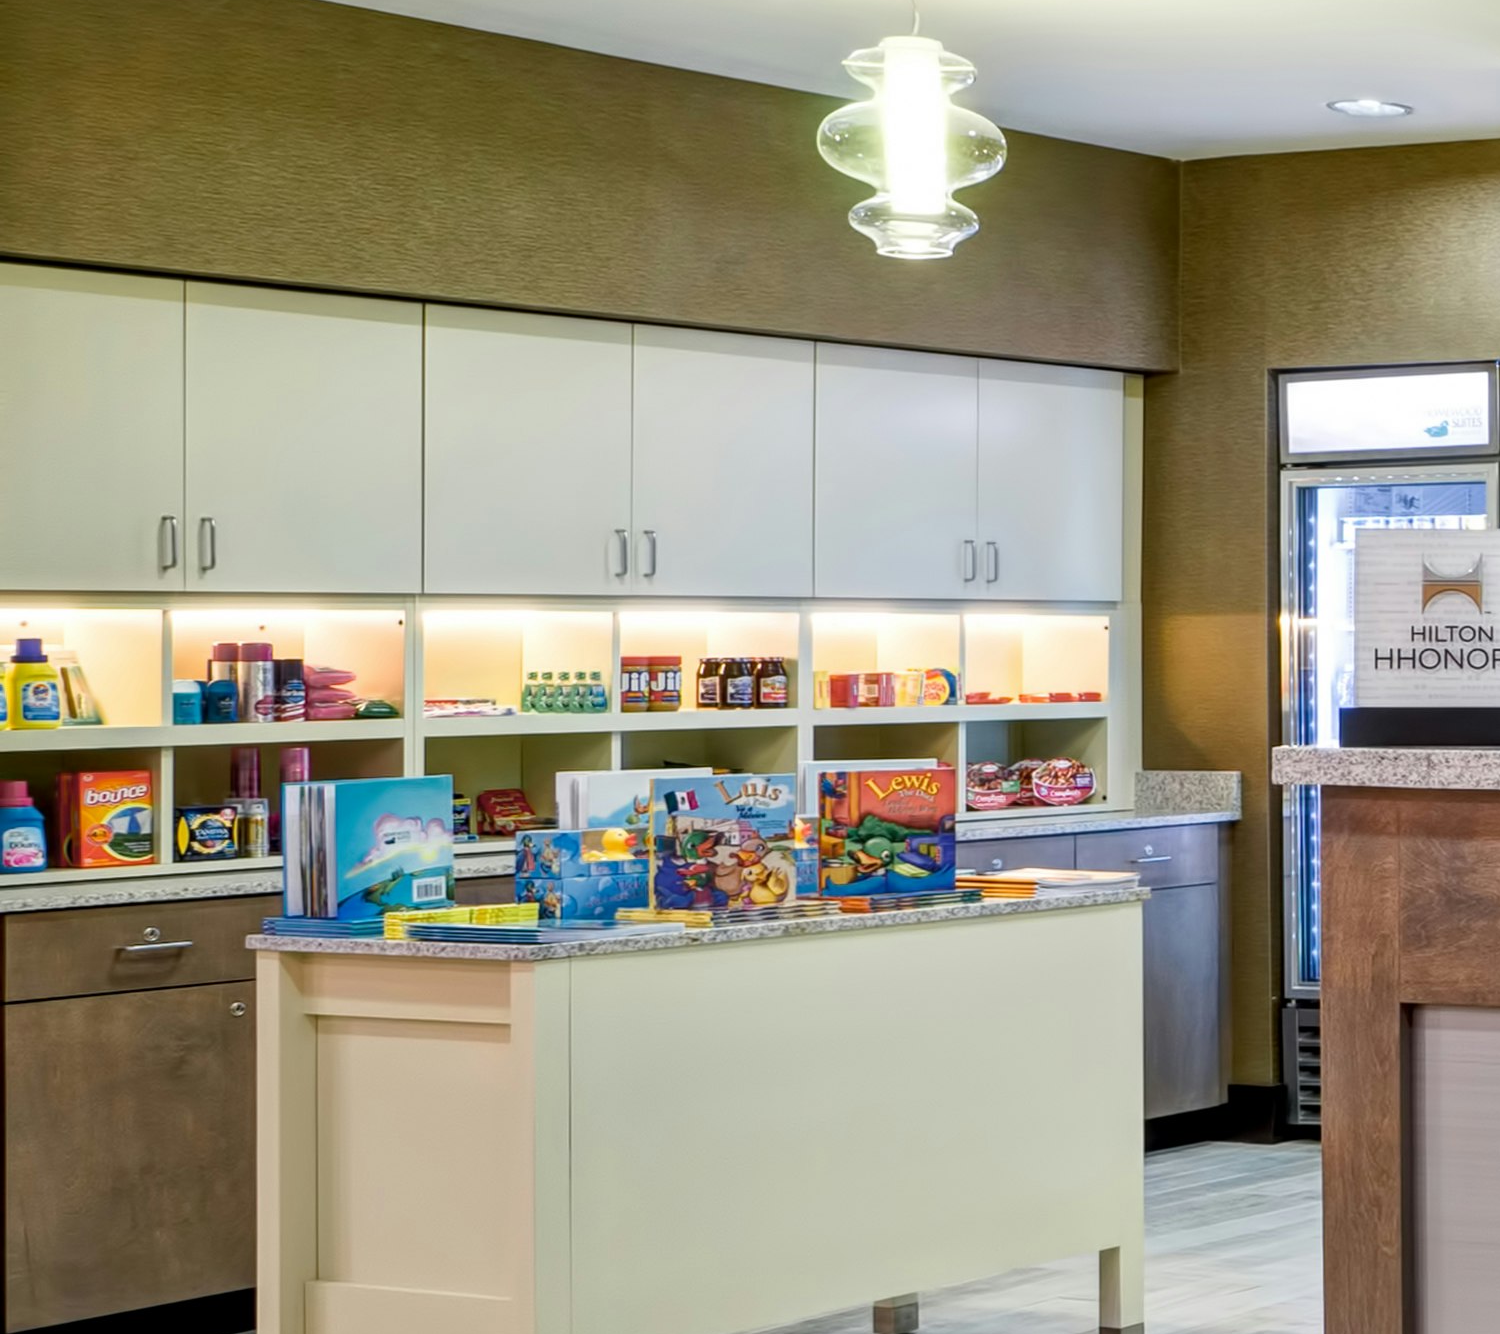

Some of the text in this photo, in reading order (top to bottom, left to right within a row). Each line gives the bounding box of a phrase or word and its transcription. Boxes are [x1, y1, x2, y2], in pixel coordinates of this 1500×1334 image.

[1410, 625, 1494, 643] HILTON
[85, 784, 148, 805] bounce
[713, 778, 782, 805] Luis
[864, 772, 942, 800] Lewis
